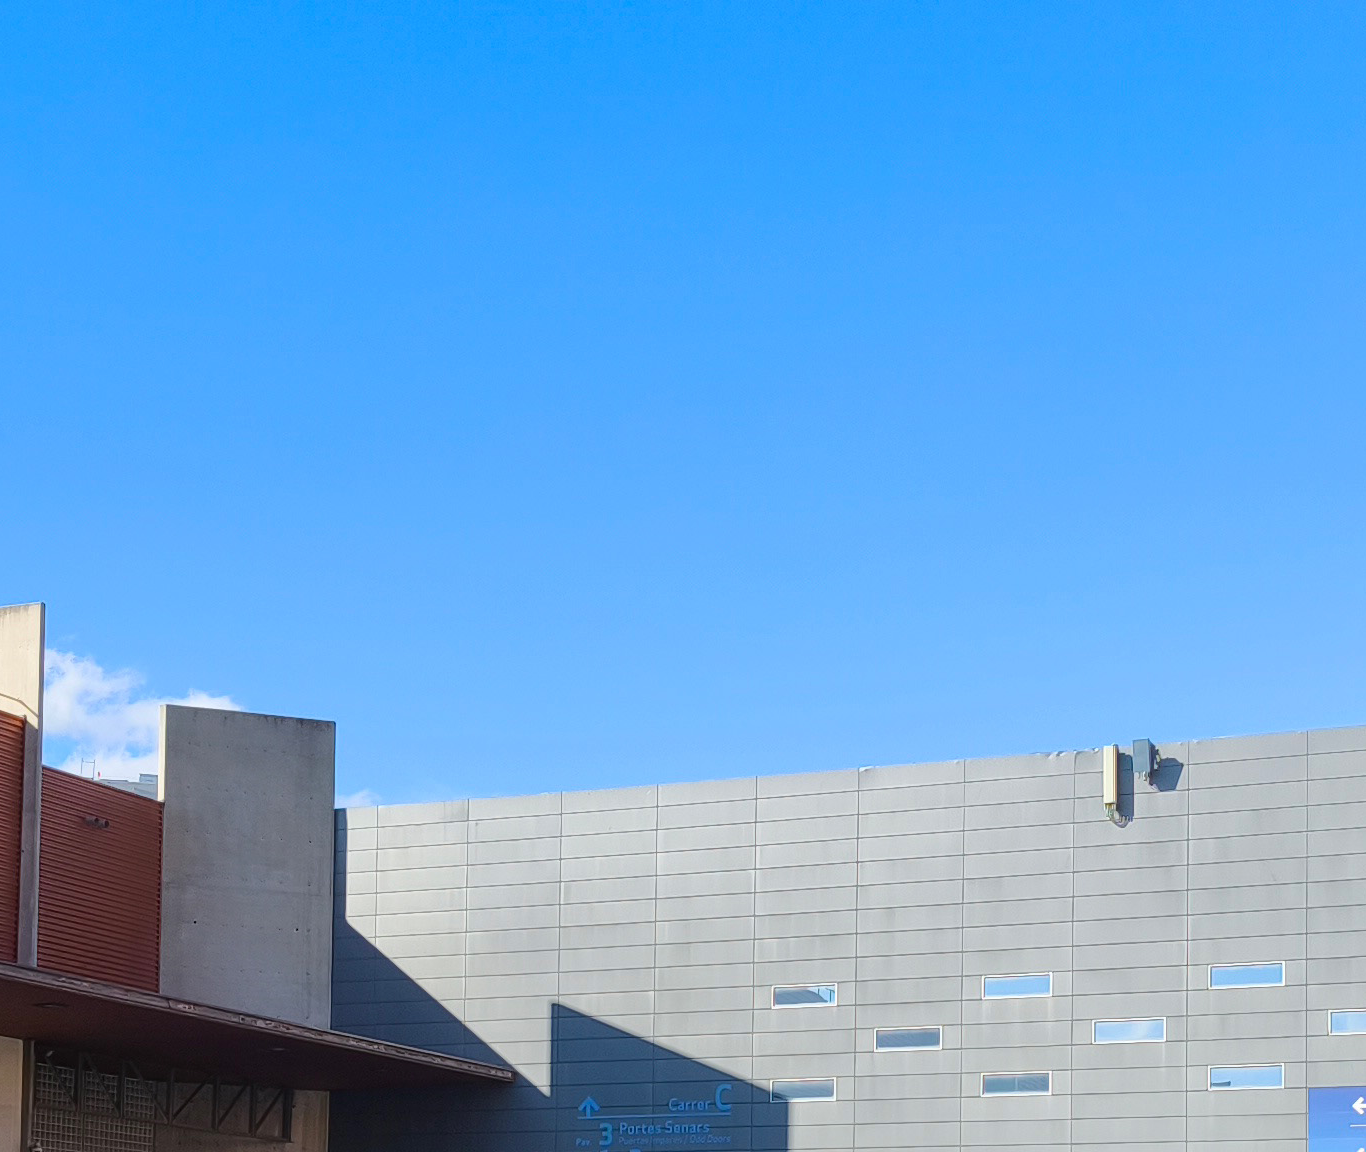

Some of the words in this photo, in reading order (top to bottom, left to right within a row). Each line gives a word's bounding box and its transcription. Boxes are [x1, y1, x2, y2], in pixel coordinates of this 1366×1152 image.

[668, 1097, 711, 1112] Carrer
[715, 1084, 732, 1111] C
[599, 1122, 613, 1146] 3
[619, 1122, 661, 1135] Portes
[664, 1120, 710, 1134] Senars
[707, 1133, 731, 1144] Doors
